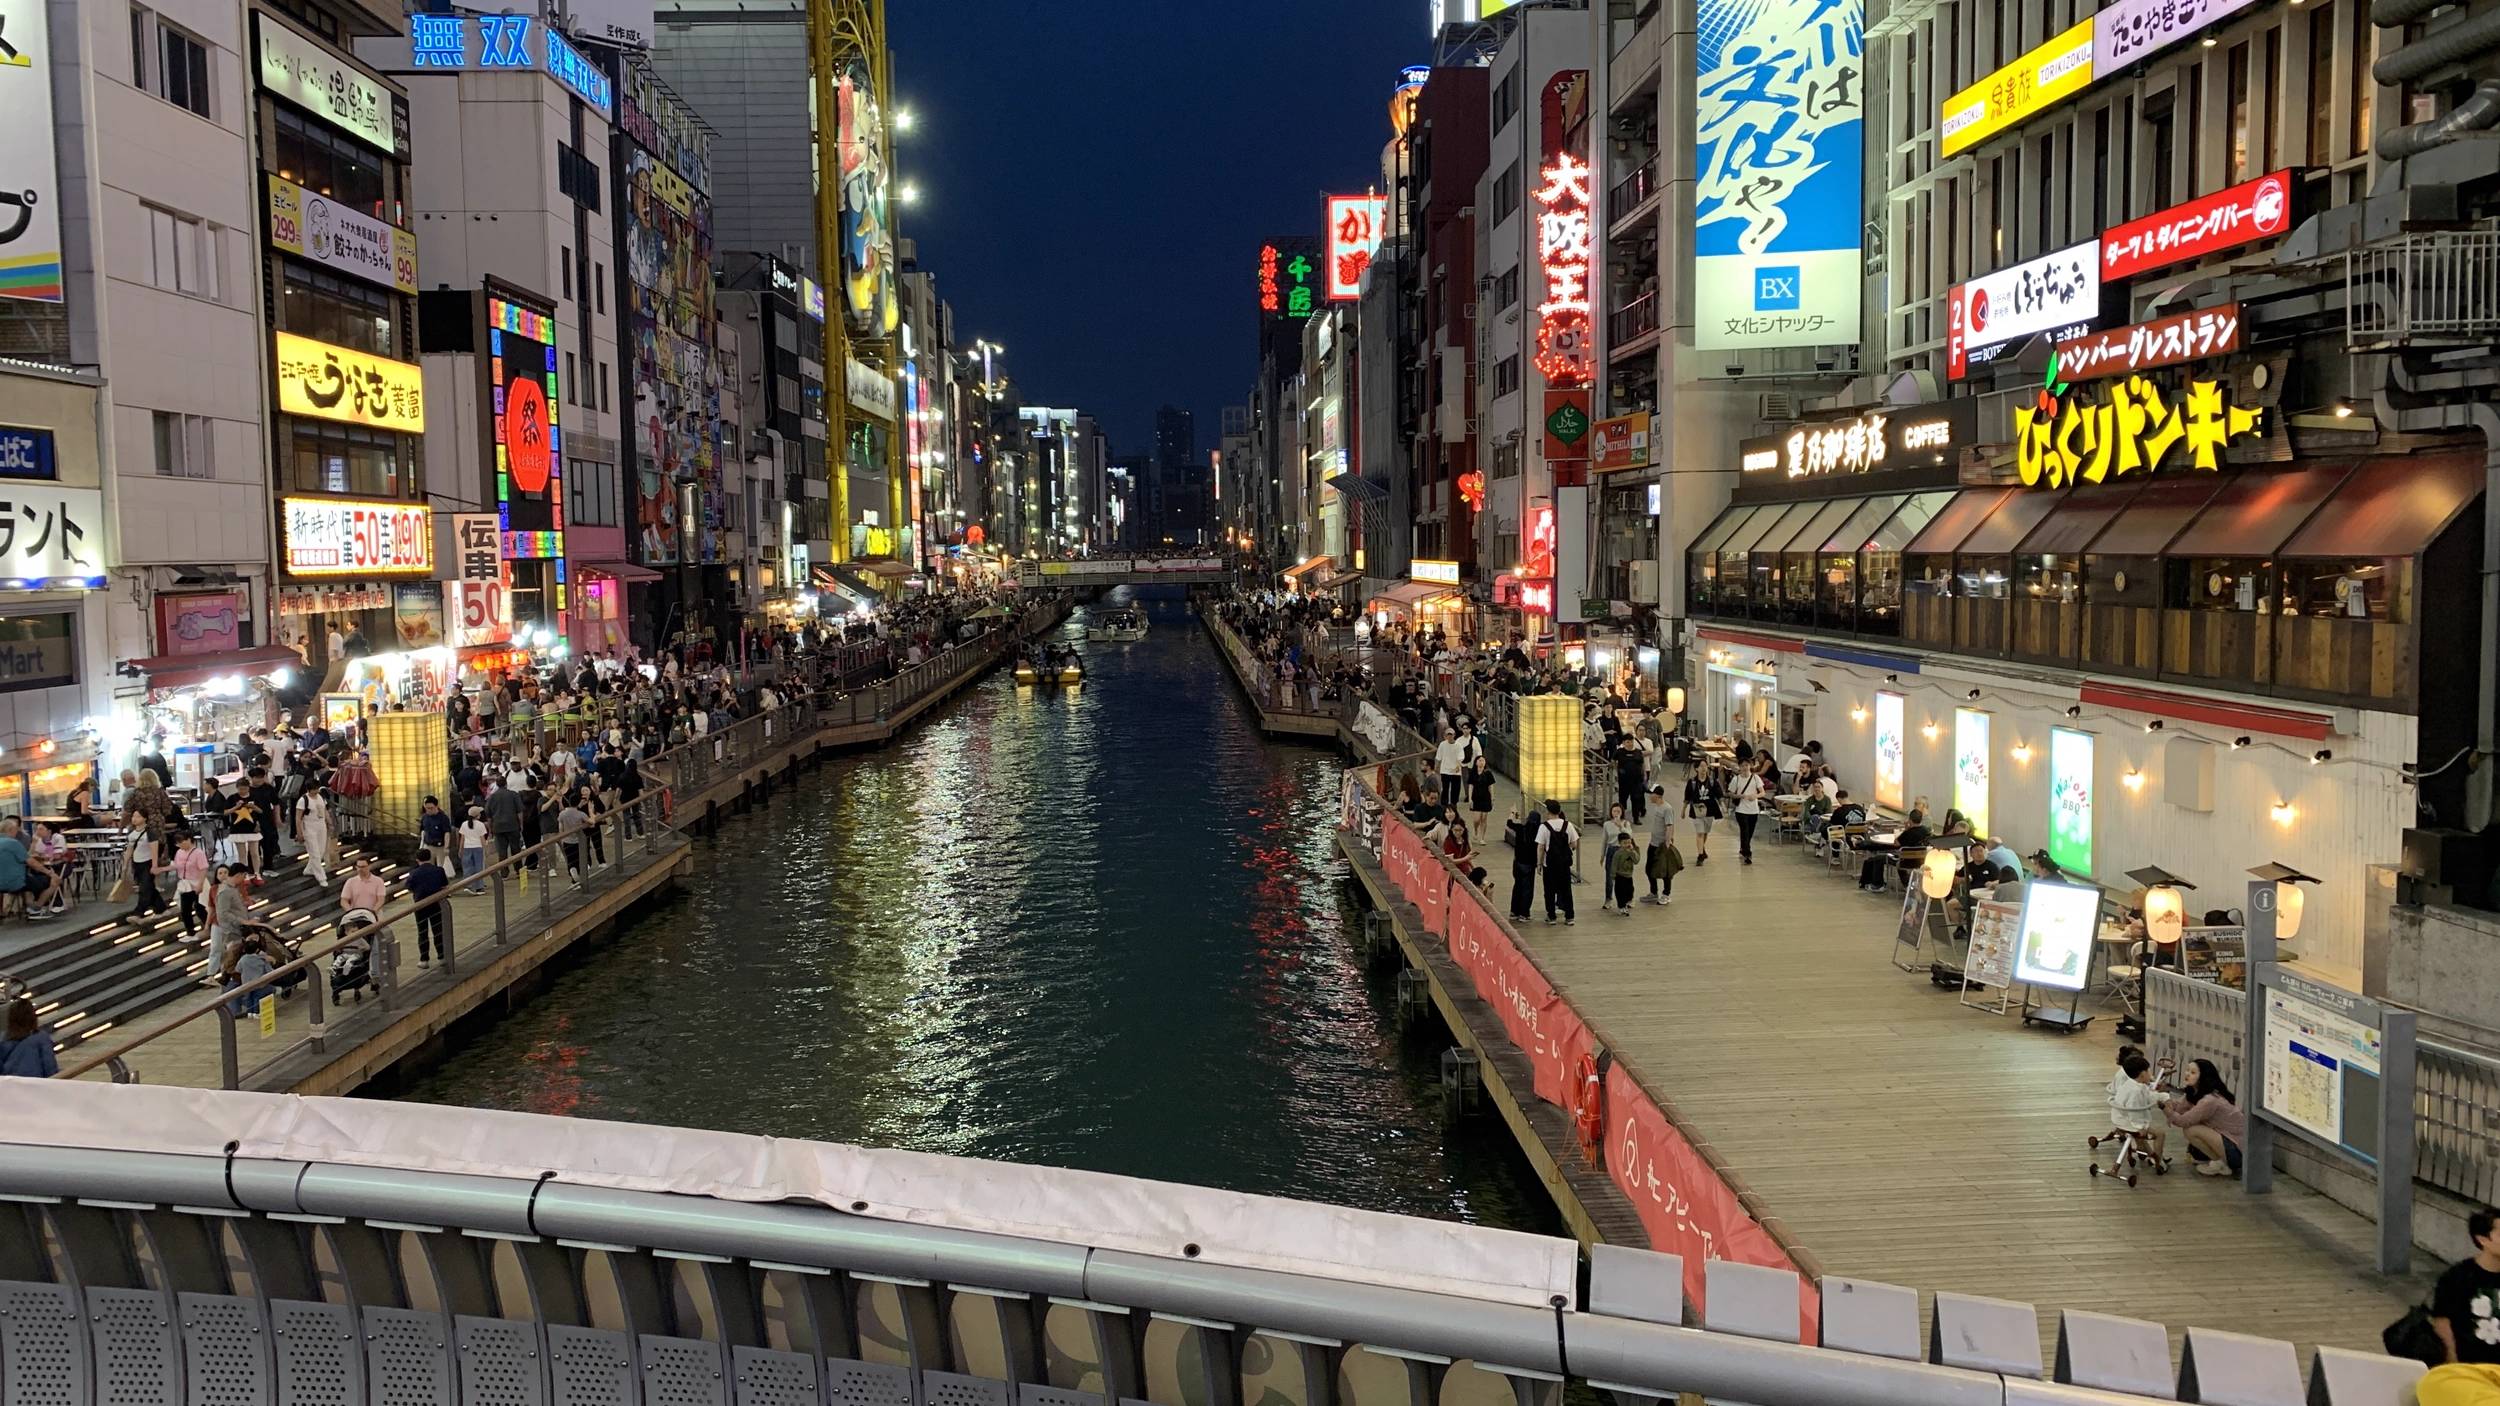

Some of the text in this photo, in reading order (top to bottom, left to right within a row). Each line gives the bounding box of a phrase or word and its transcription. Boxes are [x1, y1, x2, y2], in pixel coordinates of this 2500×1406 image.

[412, 14, 531, 66] 無双
[333, 232, 392, 271] 餃子のかっちゃん
[1287, 255, 1312, 311] 千房
[1760, 277, 1795, 300] BX
[2058, 315, 2237, 375] ハンバーグレストラン
[303, 351, 389, 418] うなぎ
[1556, 415, 1579, 429] حلال
[1786, 414, 1887, 478] 星乃珈琲店
[1904, 420, 1950, 449] COFFEE
[2015, 373, 2264, 490] びっくりドンキー
[293, 507, 340, 545] 新時代
[342, 510, 354, 567] 伝串
[354, 510, 380, 567] 50
[391, 513, 425, 566] 190
[460, 519, 499, 581] 伝串
[463, 582, 501, 629] 50
[1965, 771, 1980, 786] BBQ
[2062, 799, 2081, 816] BBQ
